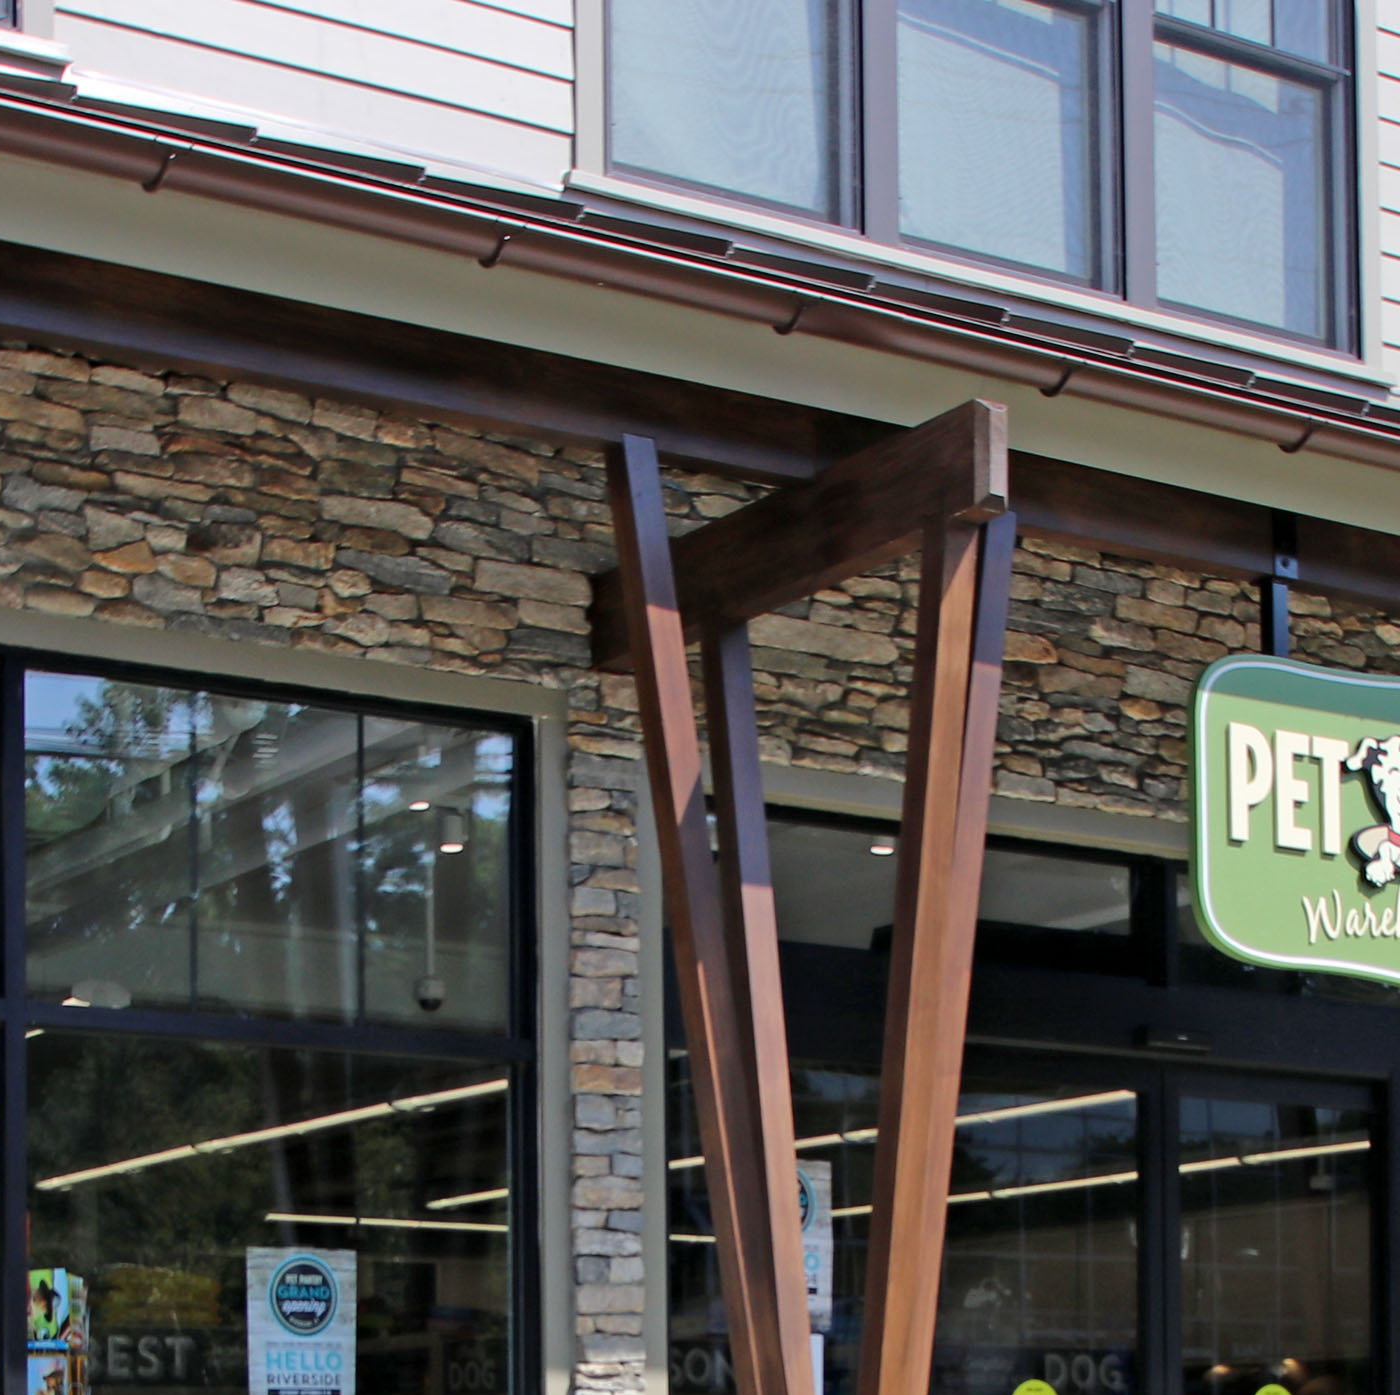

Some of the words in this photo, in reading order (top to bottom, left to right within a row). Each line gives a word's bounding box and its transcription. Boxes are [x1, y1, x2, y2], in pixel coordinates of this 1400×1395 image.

[1228, 722, 1350, 855] PET
[278, 1285, 329, 1299] GRAND
[266, 1350, 343, 1371] HELLO
[267, 1373, 341, 1385] RIVERSIDE
[1044, 1354, 1127, 1391] DOG
